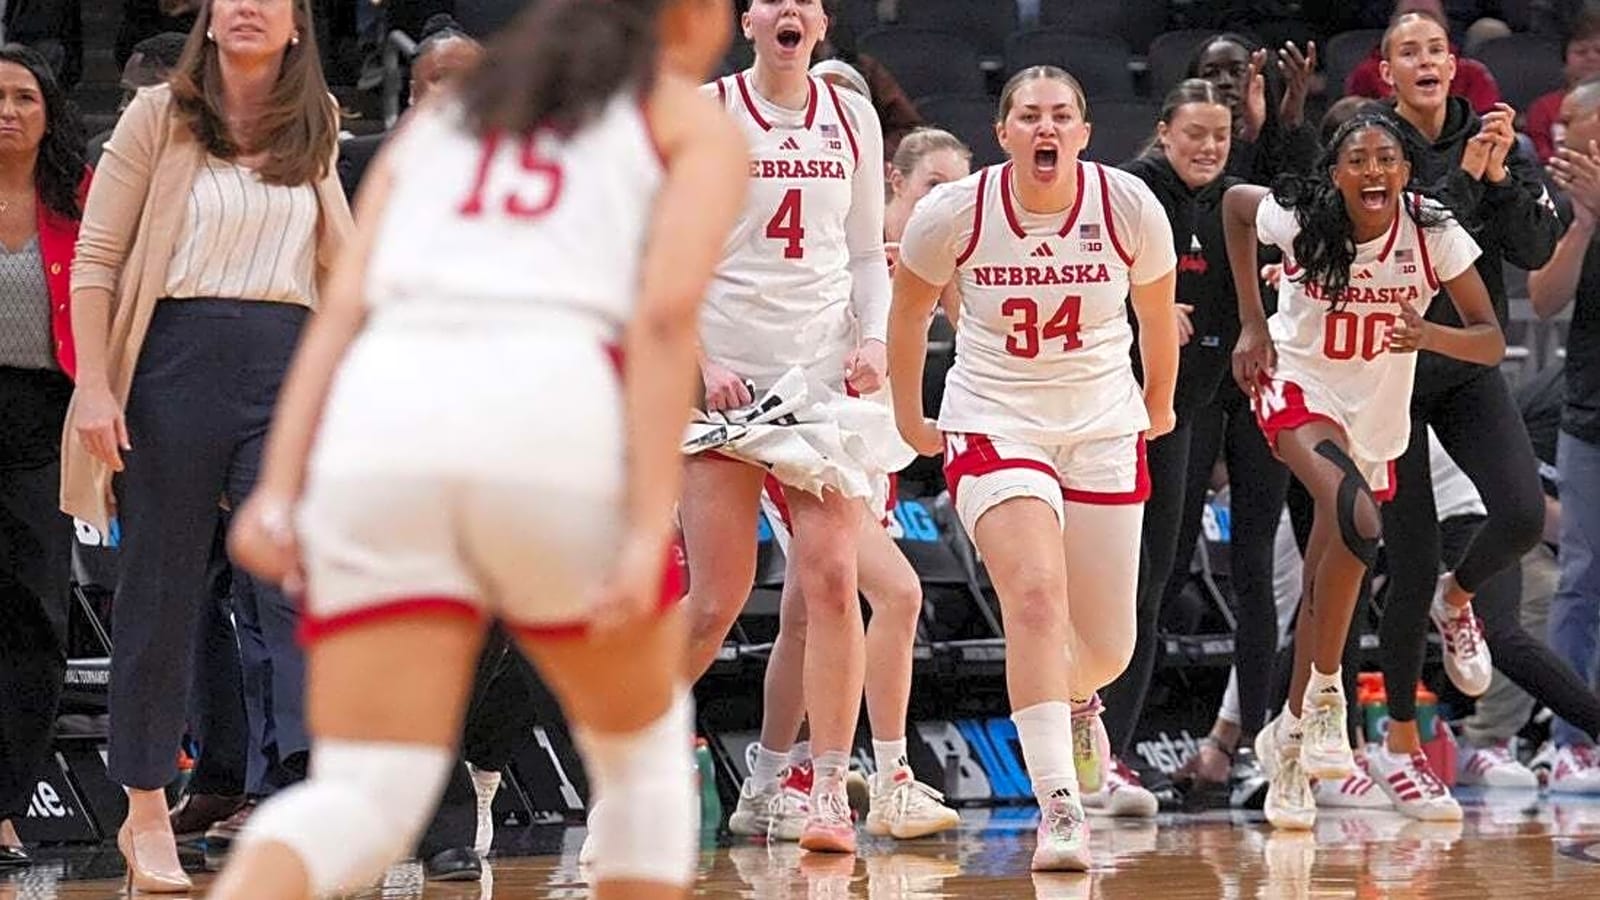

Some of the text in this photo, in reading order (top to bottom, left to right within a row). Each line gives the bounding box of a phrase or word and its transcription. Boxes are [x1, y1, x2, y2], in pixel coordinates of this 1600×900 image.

[459, 124, 567, 219] 15
[749, 160, 846, 180] EBRASKA
[766, 189, 805, 259] 4
[973, 263, 1111, 286] NEBRASKA
[1001, 296, 1083, 359] 34
